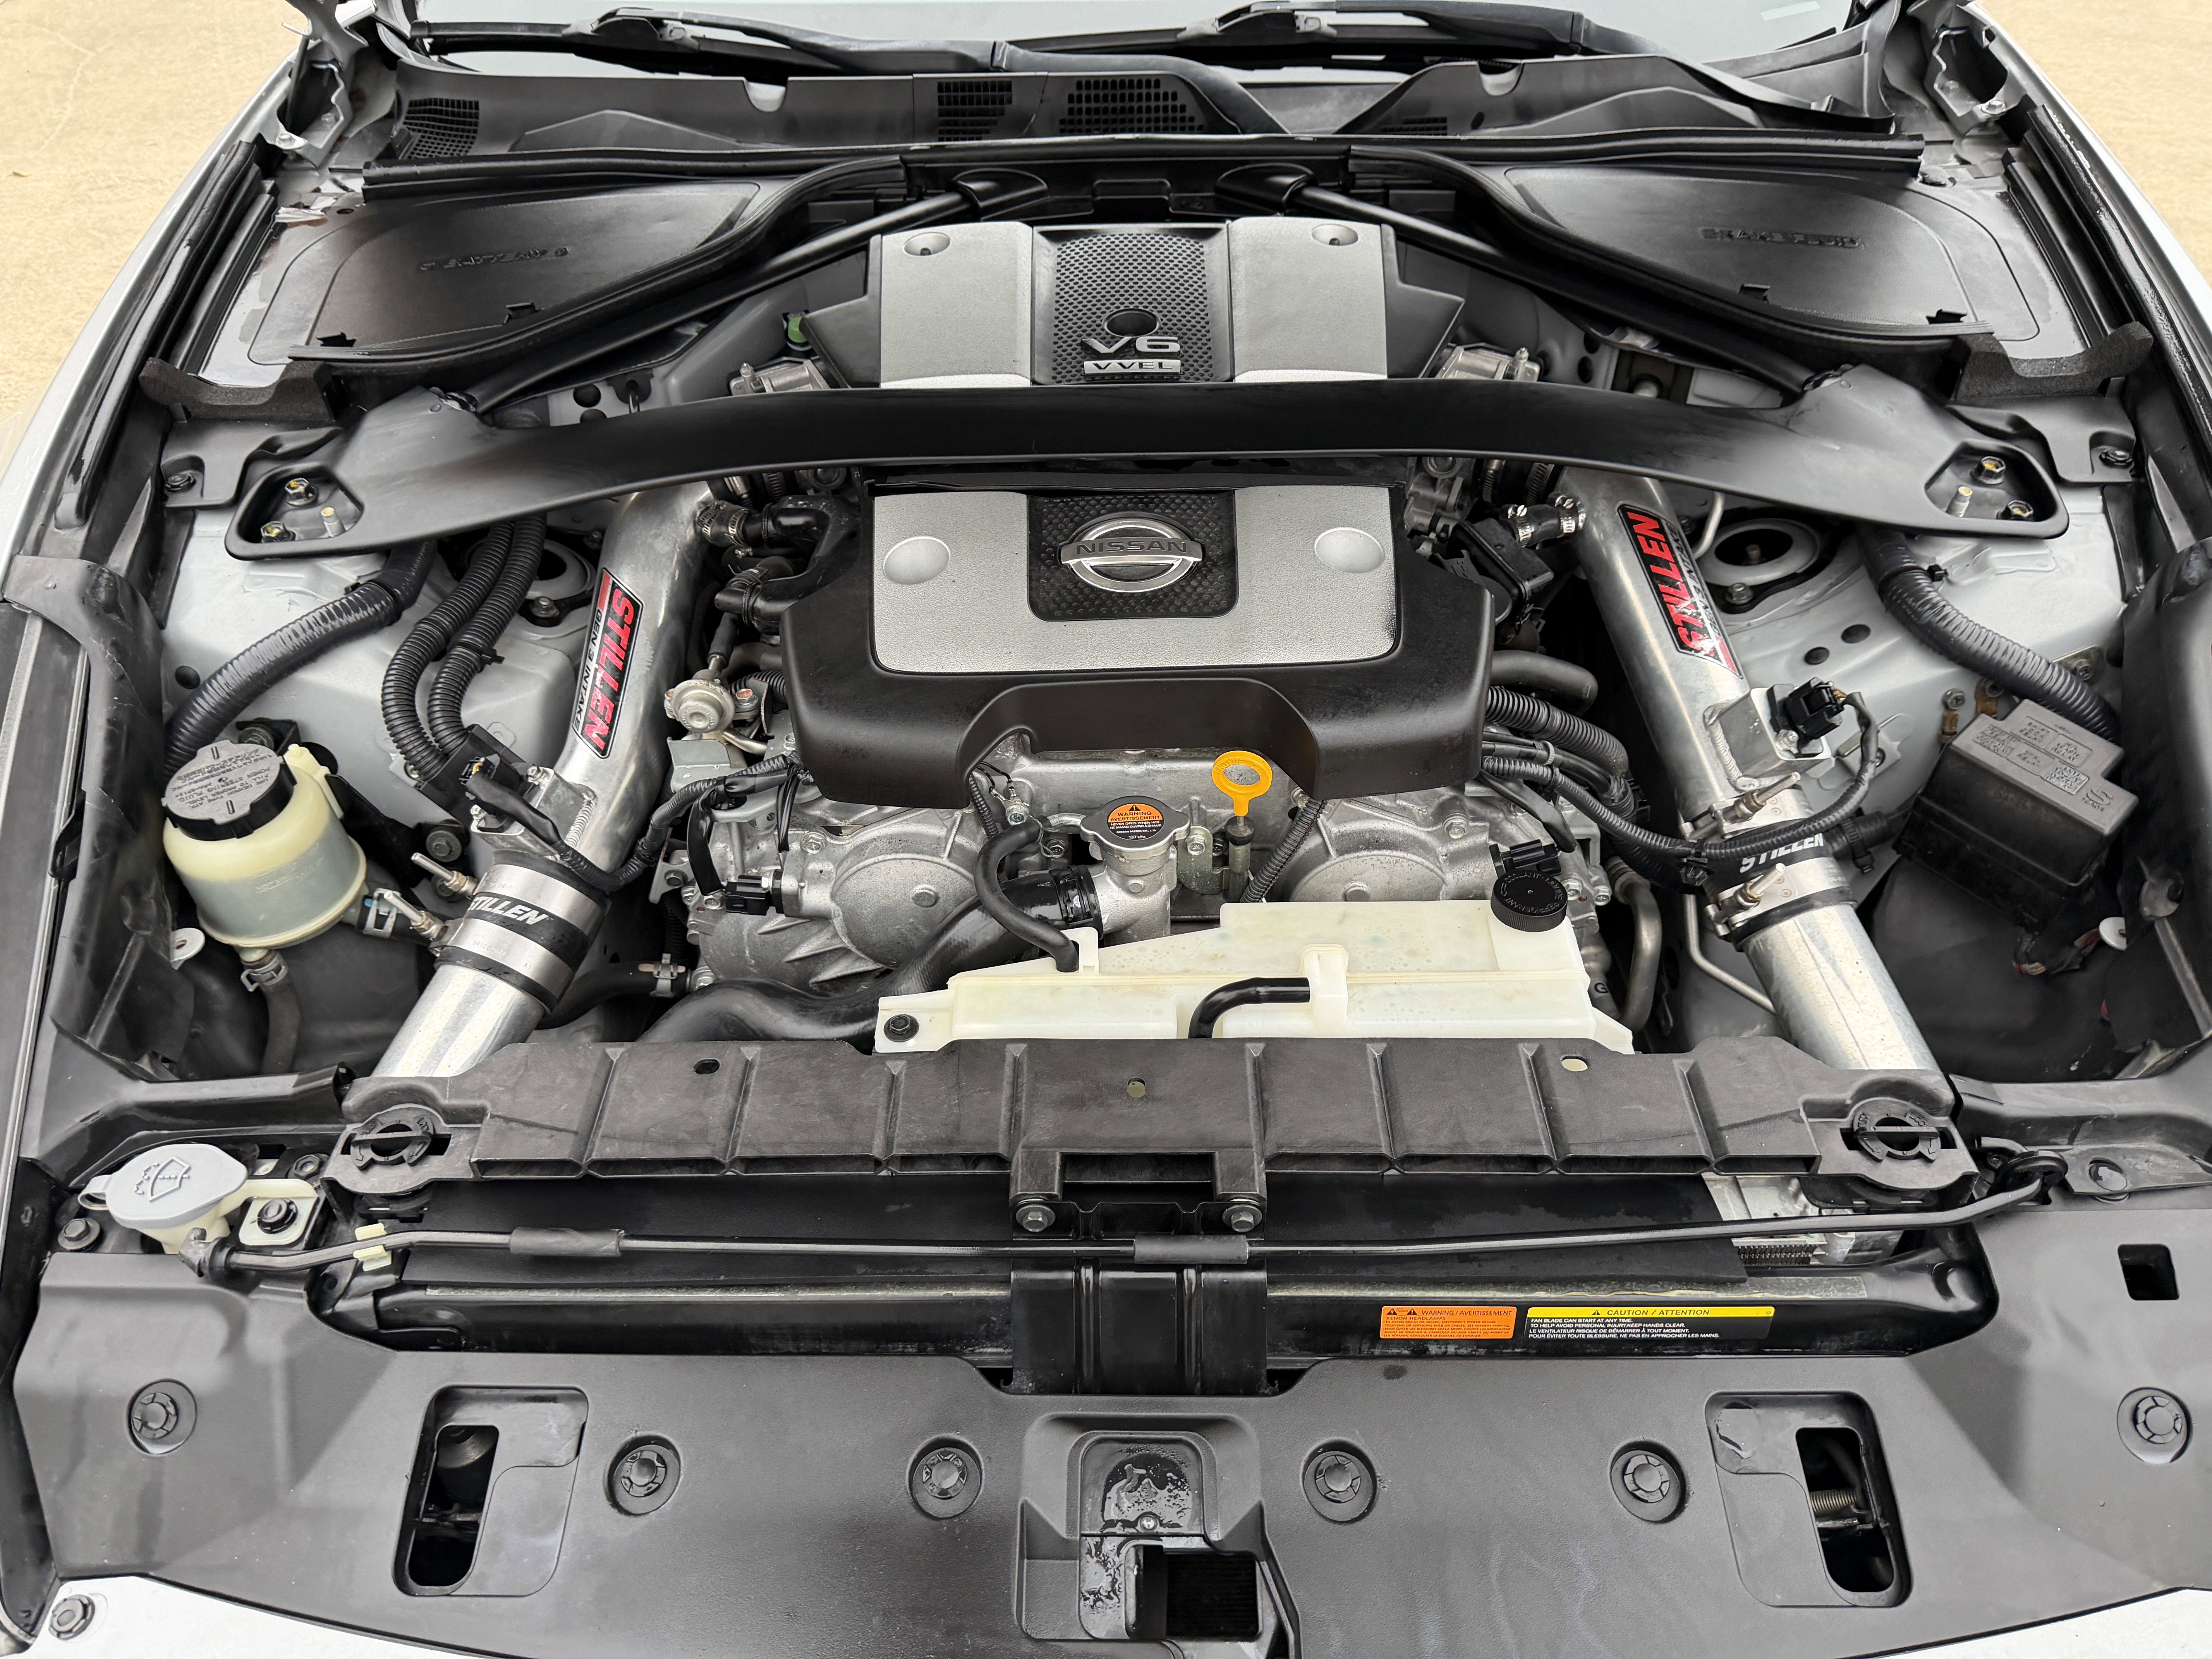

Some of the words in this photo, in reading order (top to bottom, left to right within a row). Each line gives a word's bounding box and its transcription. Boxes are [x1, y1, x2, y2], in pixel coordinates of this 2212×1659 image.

[1082, 336, 1180, 354] V6
[1092, 361, 1173, 370] VVEL
[1077, 541, 1187, 555] NISSAN
[1627, 511, 1715, 657] STILLEN
[589, 611, 603, 646] GEN
[587, 649, 595, 660] 3
[584, 588, 635, 750] STILLEN
[572, 663, 592, 732] INTAKE
[1214, 759, 1245, 774] ENGINE
[467, 896, 549, 925] STILLEN
[1594, 982, 1607, 993] G
